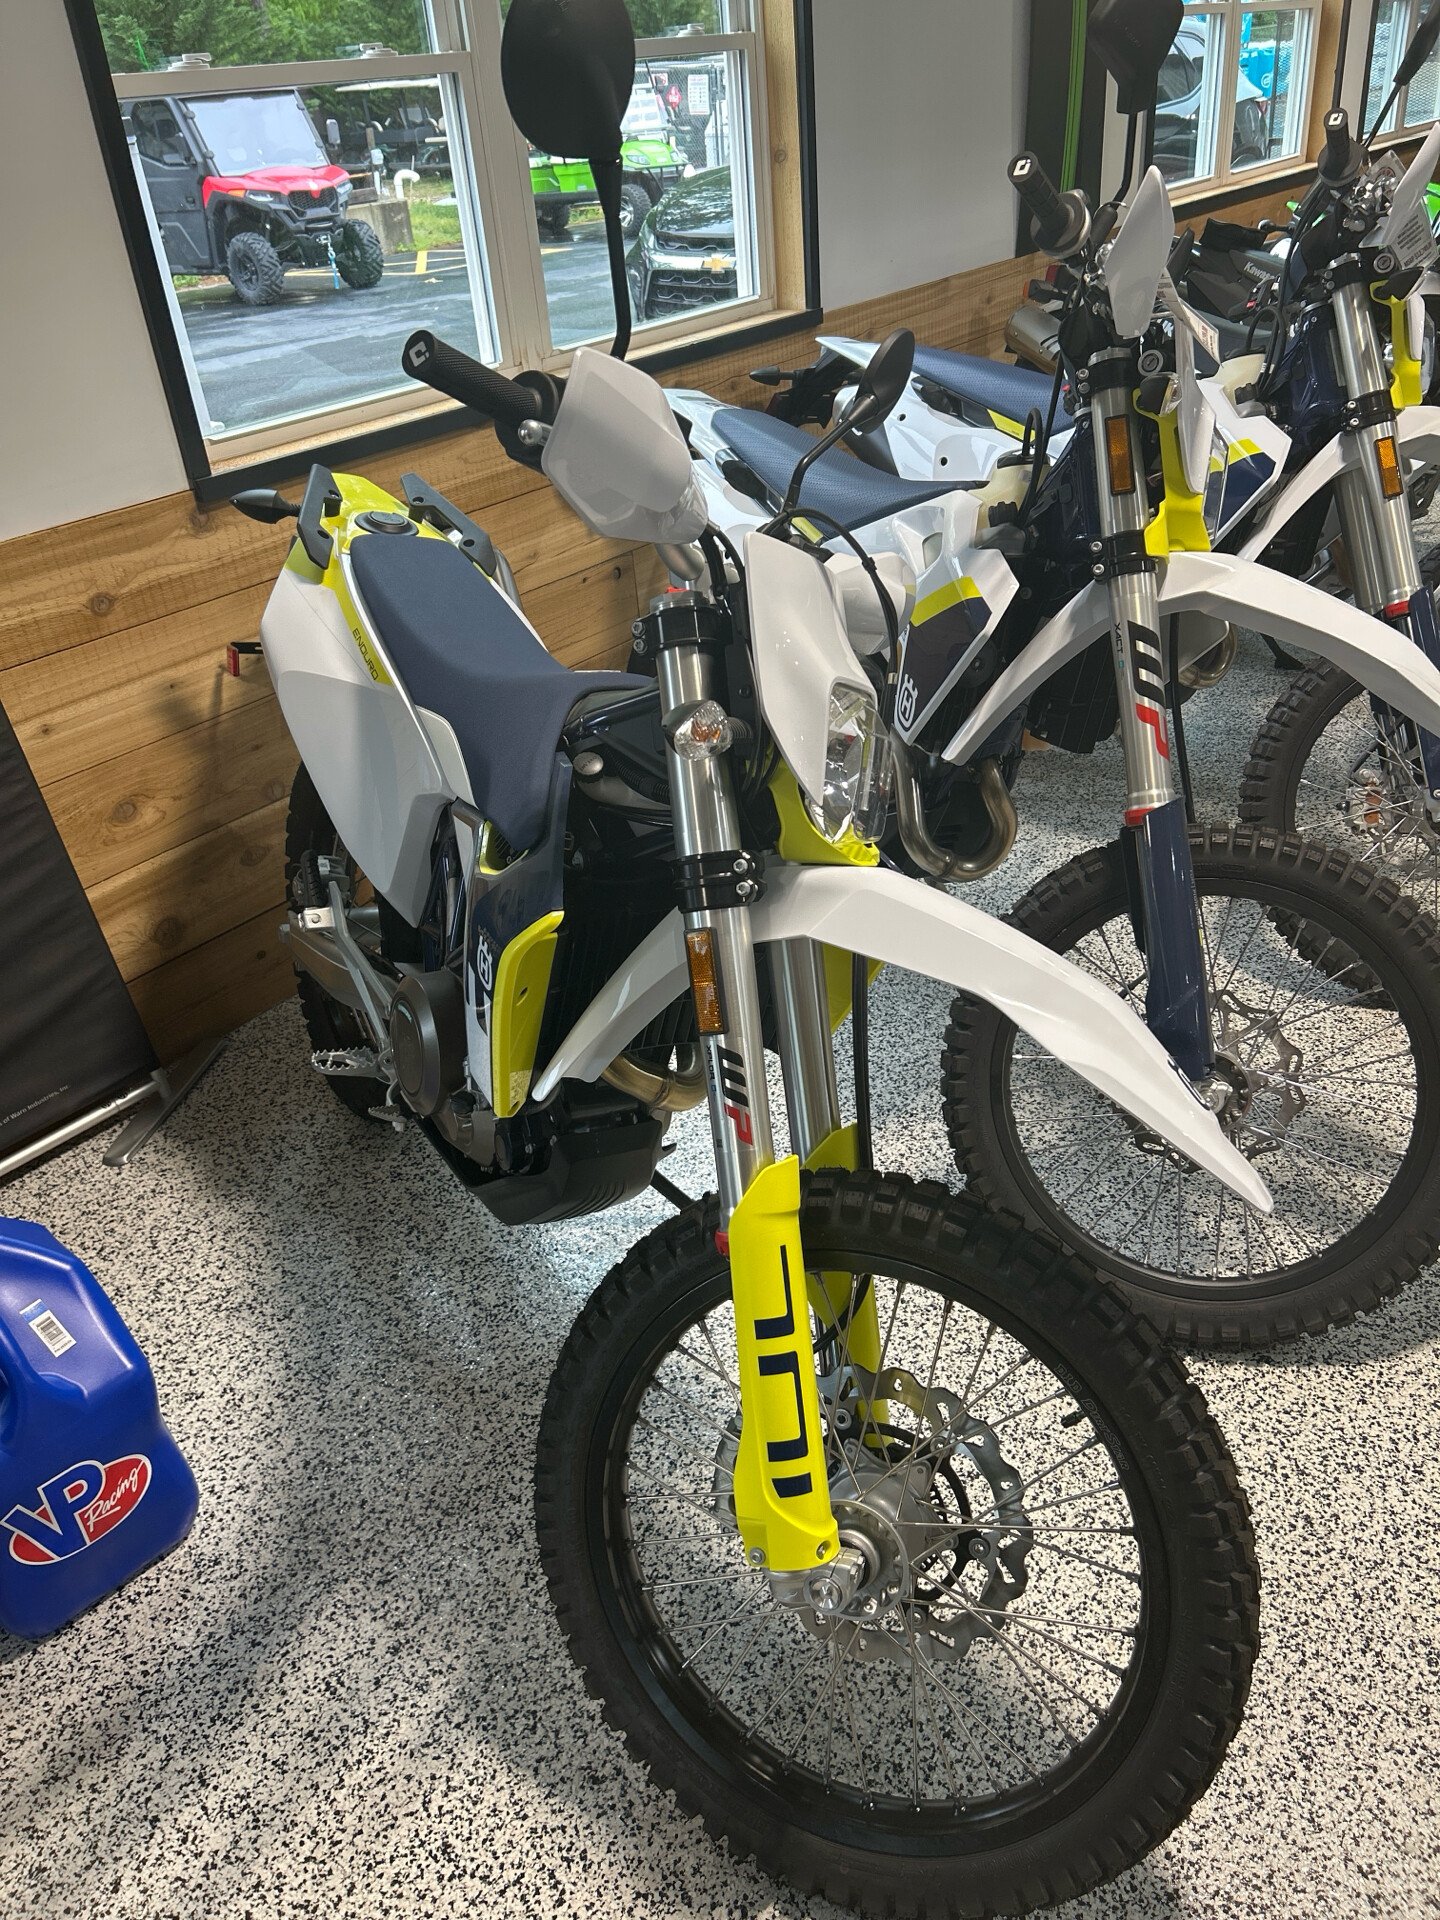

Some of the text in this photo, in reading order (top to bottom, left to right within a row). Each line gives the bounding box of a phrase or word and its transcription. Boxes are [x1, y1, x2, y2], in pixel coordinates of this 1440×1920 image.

[352, 628, 379, 681] ENDURO
[1113, 621, 1124, 654] XACT
[10, 1108, 28, 1121] Warn
[716, 1044, 754, 1146] WP
[0, 1459, 146, 1559] VP Racing
